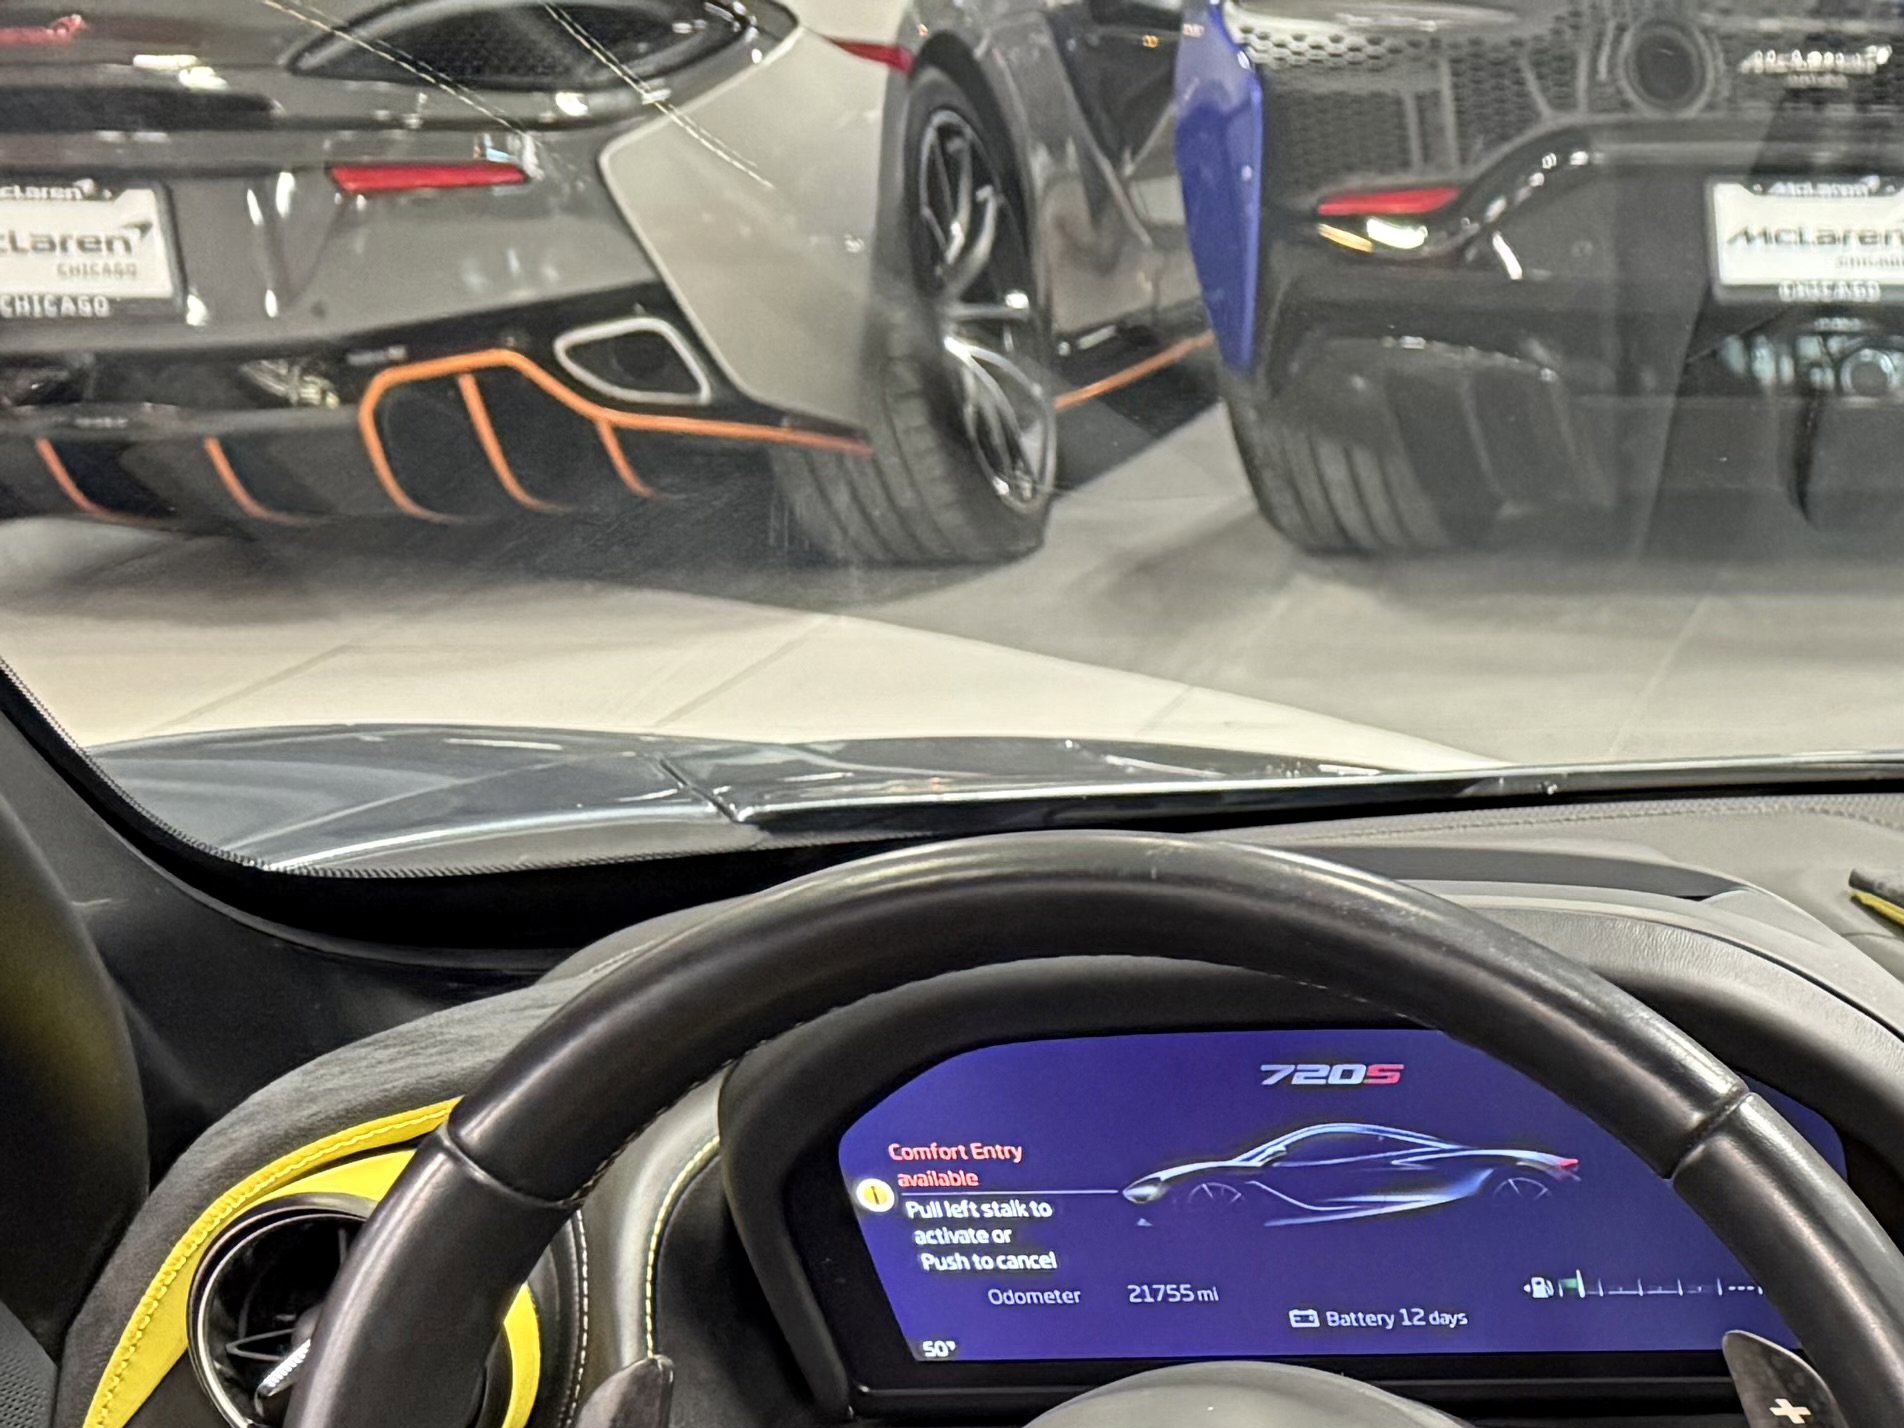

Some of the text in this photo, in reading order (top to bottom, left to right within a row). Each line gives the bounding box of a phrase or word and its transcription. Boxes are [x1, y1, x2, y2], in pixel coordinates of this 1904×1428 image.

[0, 184, 84, 200] cLaren
[0, 228, 133, 255] Laren
[57, 262, 138, 280] CHICAGO
[1260, 1063, 1405, 1086] 720S
[888, 1142, 1023, 1163] Comfort Entry
[897, 1169, 980, 1188] available
[905, 1199, 1053, 1219] Pull left stalk to
[914, 1227, 1012, 1245] activate or
[920, 1251, 1058, 1271] Push to cancel
[987, 1288, 1081, 1305] Odometer
[1127, 1284, 1220, 1303] 21755 mi
[1325, 1308, 1469, 1330] Battery 12 days
